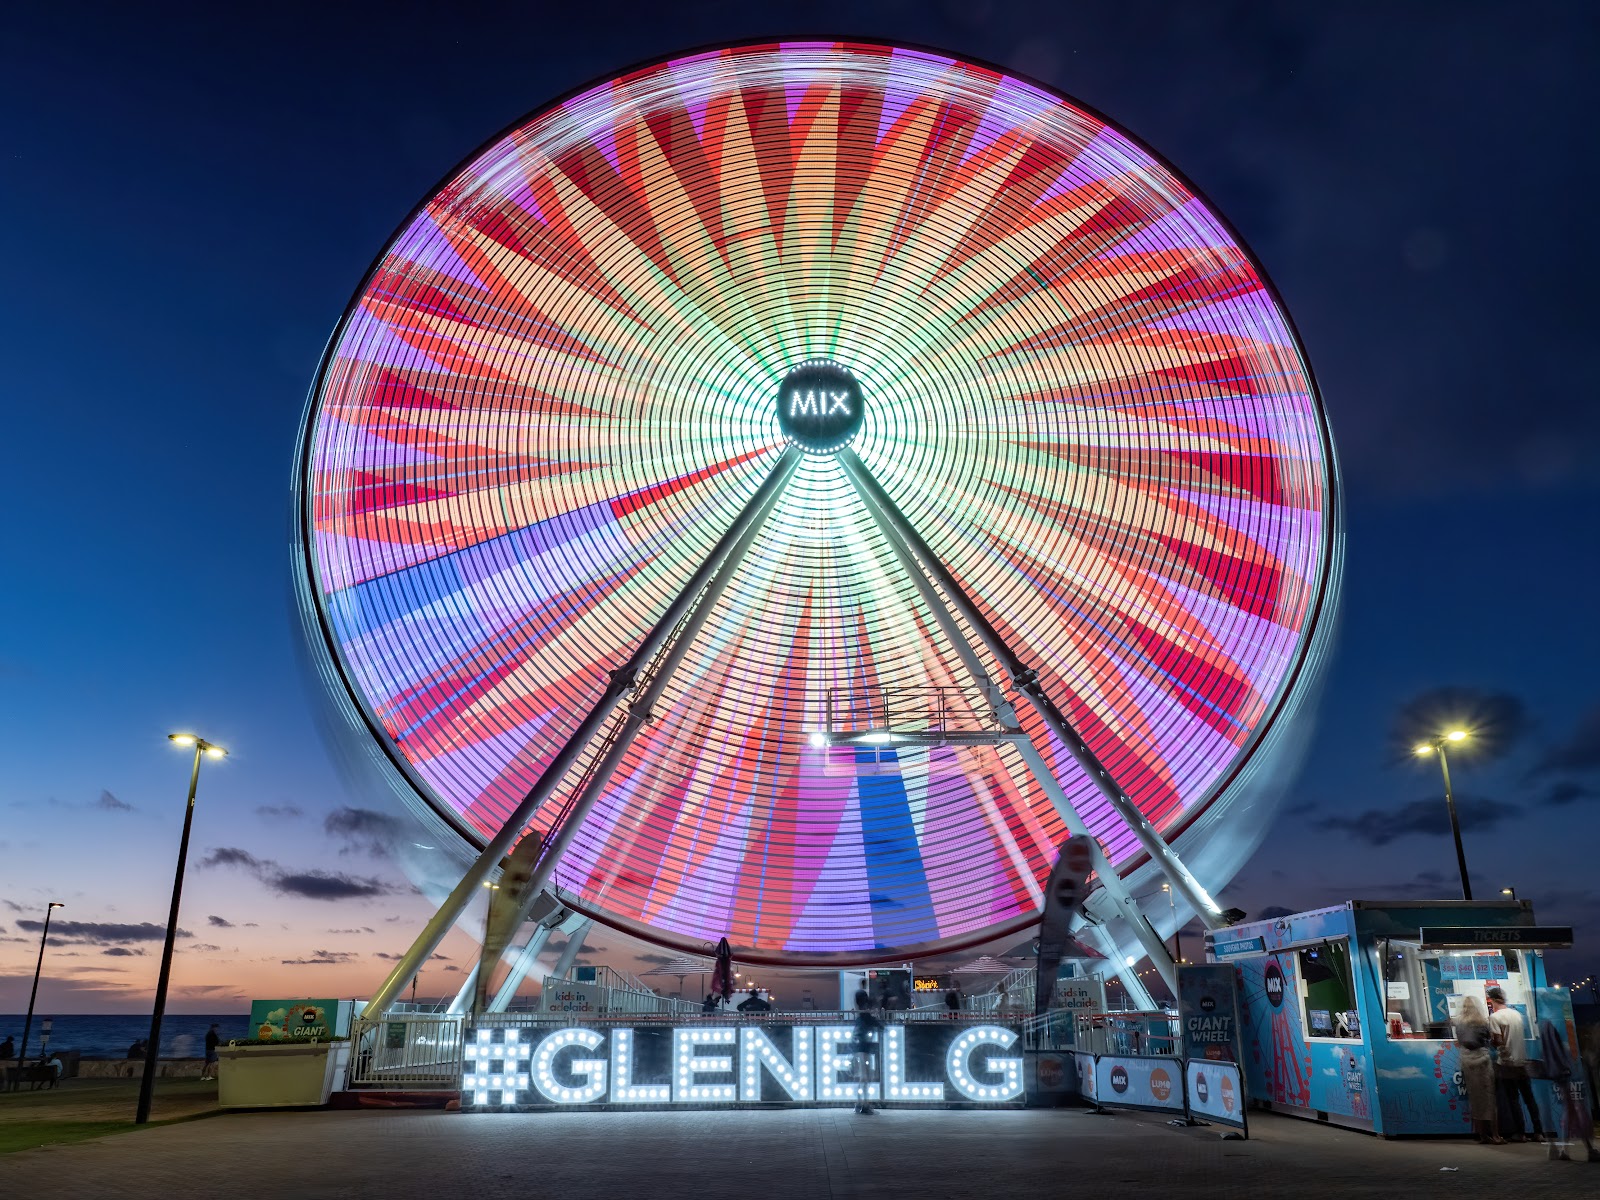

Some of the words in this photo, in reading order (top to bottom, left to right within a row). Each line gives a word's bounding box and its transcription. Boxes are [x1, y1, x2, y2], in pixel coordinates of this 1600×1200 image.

[790, 390, 851, 416] MIX
[1474, 930, 1521, 940] TICKETS
[1266, 977, 1282, 993] MIX
[555, 991, 575, 1001] kids
[576, 991, 586, 1001] in
[1057, 987, 1078, 997] kids
[1078, 987, 1088, 997] in
[549, 1002, 594, 1012] adelaide
[1187, 1016, 1232, 1031] GIANT
[294, 1026, 325, 1036] GIANT
[1191, 1030, 1231, 1042] WHEEL
[1112, 1075, 1126, 1086] MIX
[1151, 1079, 1171, 1089] LUMO
[1552, 1081, 1583, 1092] GNT
[1556, 1091, 1584, 1101] WEEL
